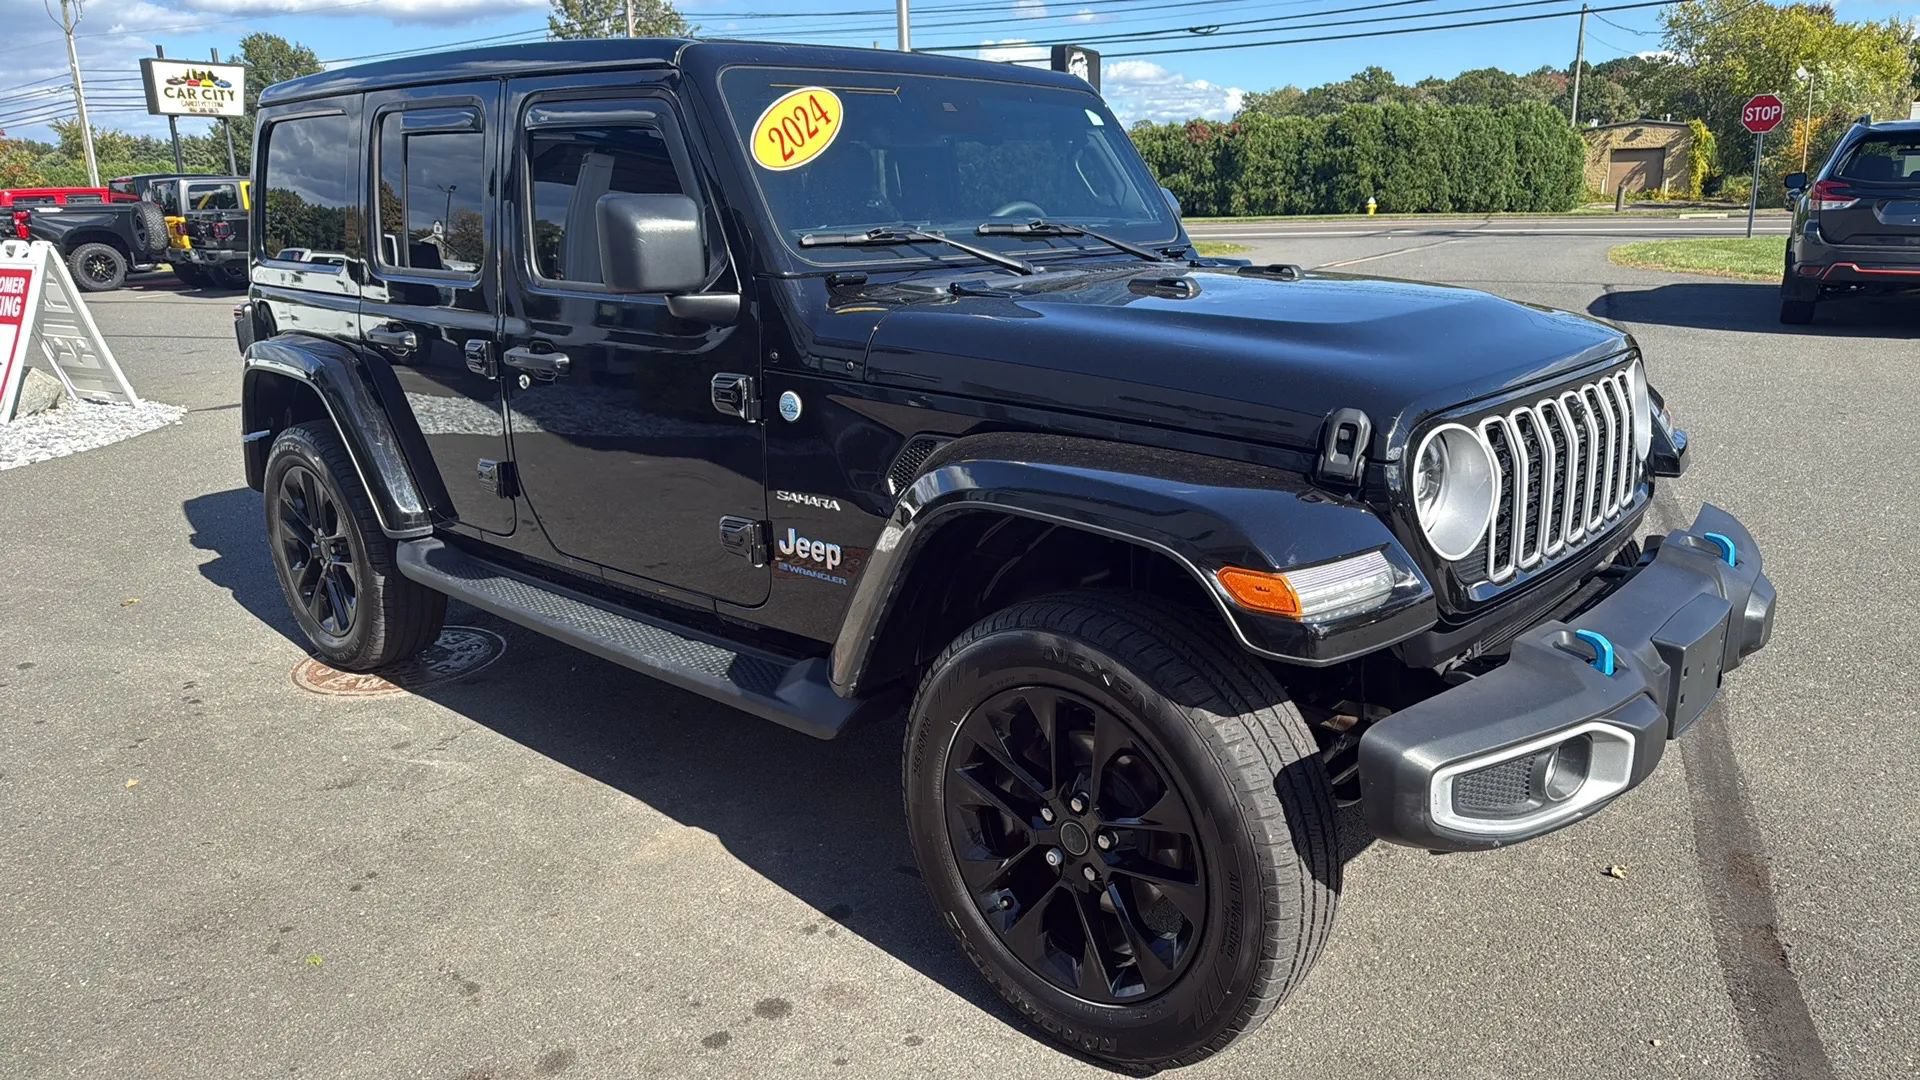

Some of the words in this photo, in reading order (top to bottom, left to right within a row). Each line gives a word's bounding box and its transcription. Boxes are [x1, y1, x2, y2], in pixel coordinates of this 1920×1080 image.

[163, 87, 197, 100] CAR
[201, 89, 235, 102] CITY
[1744, 105, 1781, 122] STOP
[768, 94, 832, 161] 2024
[0, 296, 22, 318] ING
[776, 490, 841, 512] SAHARA
[778, 527, 841, 571] Jeep
[785, 564, 848, 586] WRANGLER
[1043, 645, 1161, 720] NEXEN
